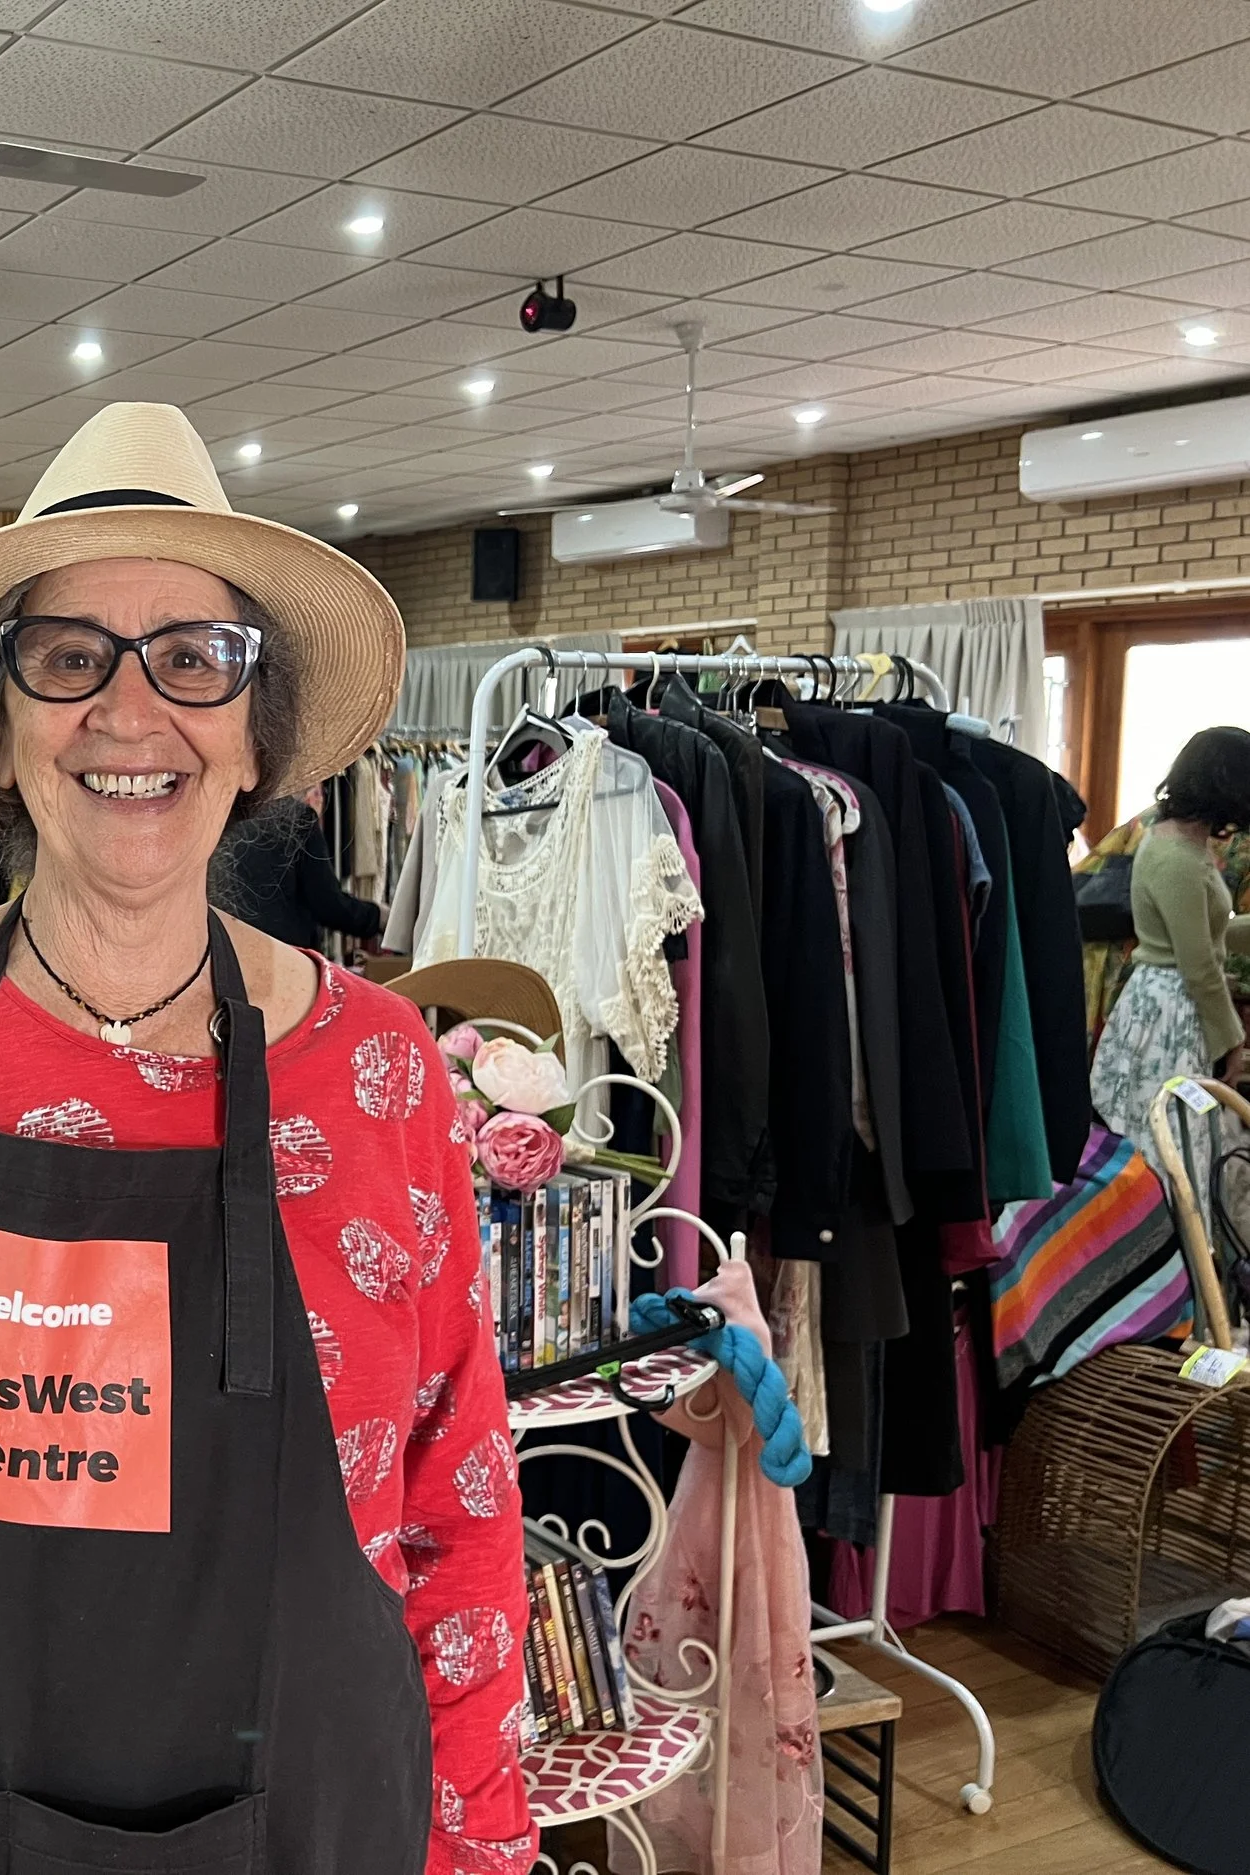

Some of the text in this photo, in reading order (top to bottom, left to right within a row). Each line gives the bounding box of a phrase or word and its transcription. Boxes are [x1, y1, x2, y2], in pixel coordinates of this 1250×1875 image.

[537, 1234, 547, 1320] Sydney White
[585, 1616, 600, 1657] HAMLET
